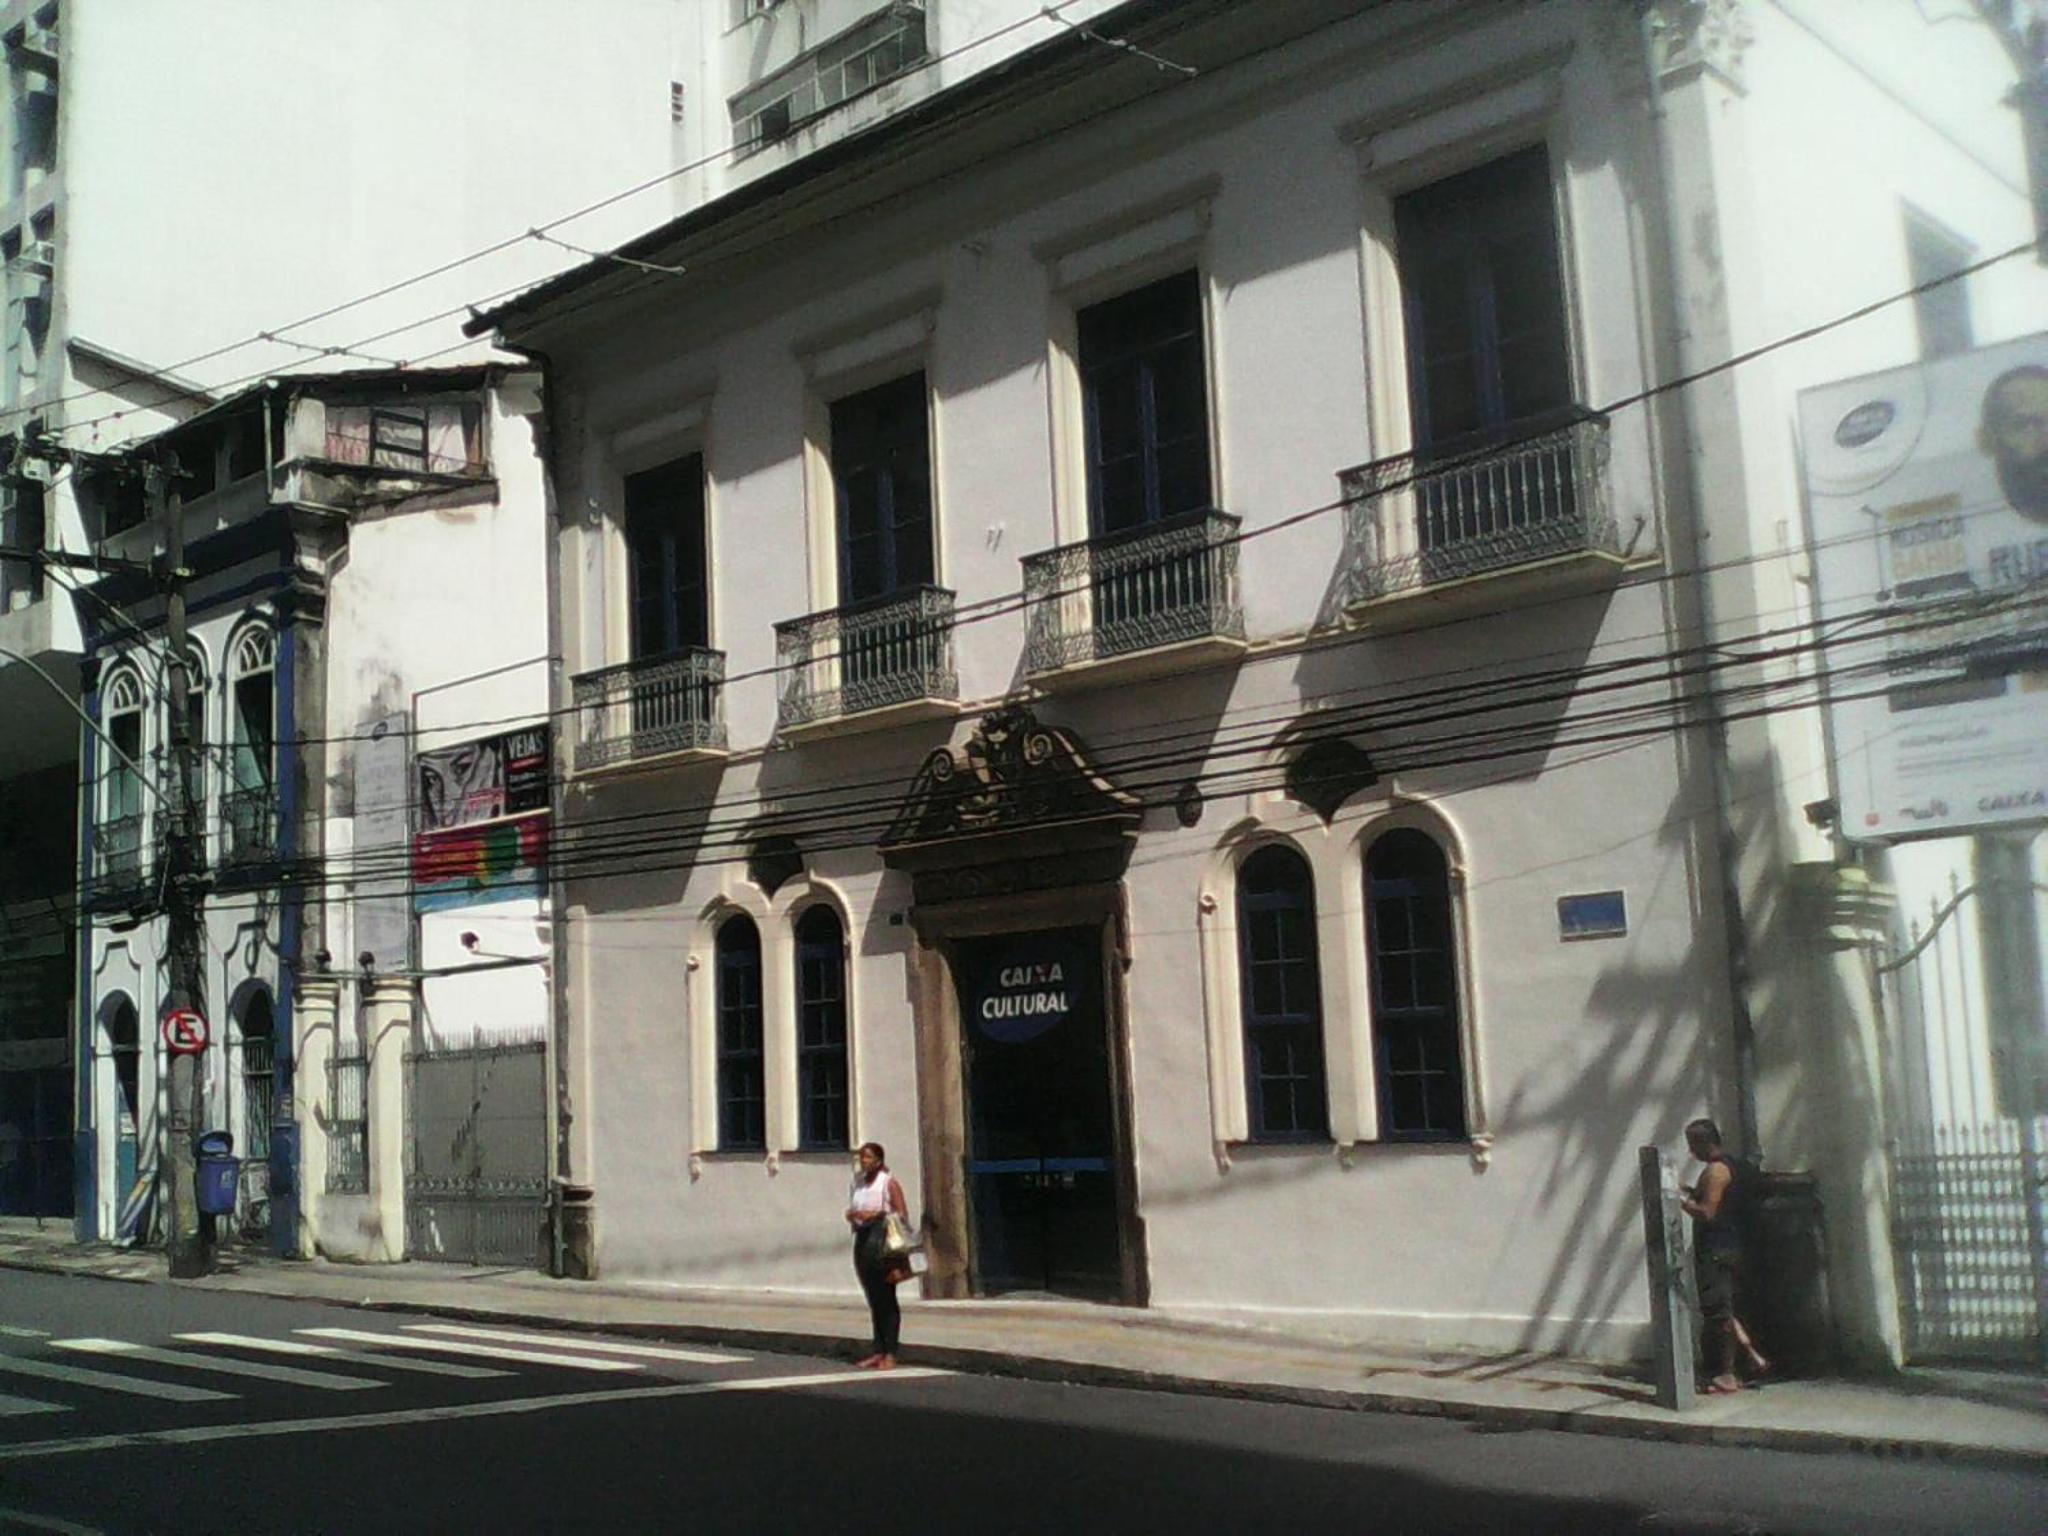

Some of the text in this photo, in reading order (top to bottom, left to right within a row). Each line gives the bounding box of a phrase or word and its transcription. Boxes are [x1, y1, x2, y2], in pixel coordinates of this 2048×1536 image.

[1000, 963, 1063, 988] CAIXA
[982, 991, 1069, 1019] CULTURAL
[175, 1018, 196, 1044] E
